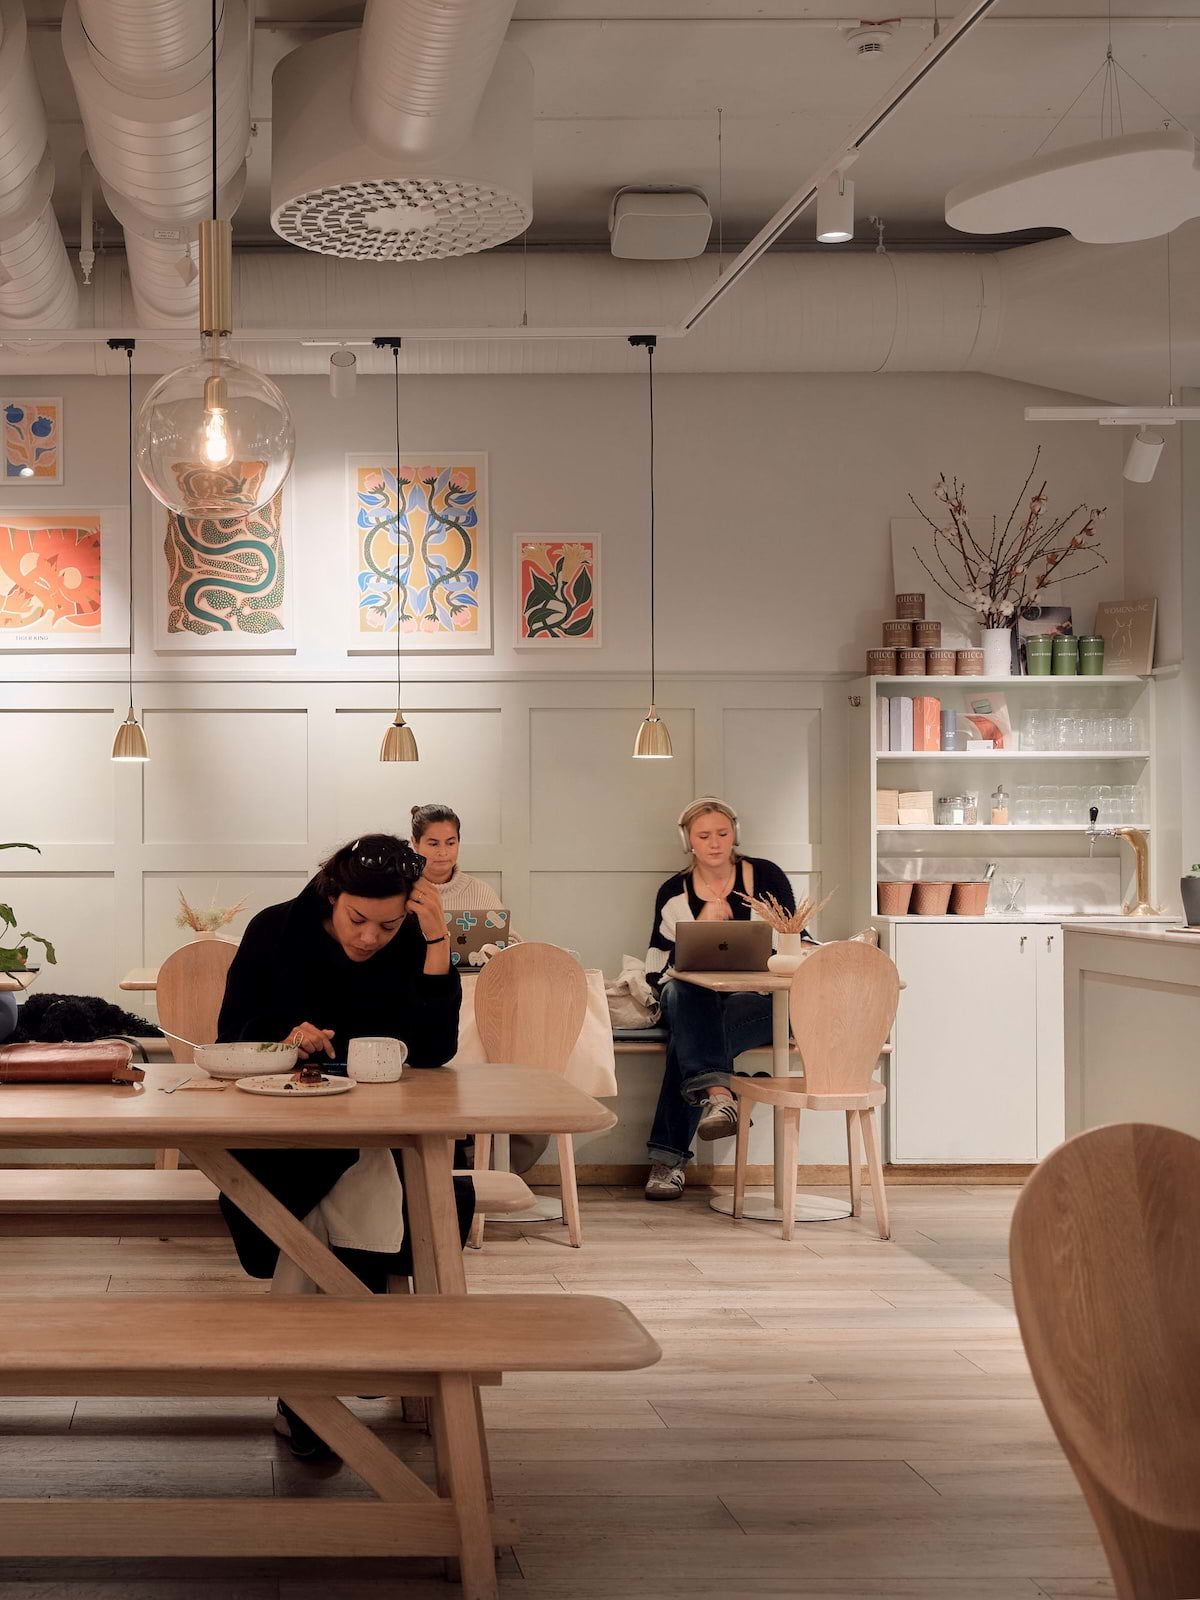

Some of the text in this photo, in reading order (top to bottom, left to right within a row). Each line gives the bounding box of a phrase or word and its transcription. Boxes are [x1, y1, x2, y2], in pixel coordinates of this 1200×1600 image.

[897, 595, 923, 603] CHICCA
[885, 623, 911, 631] CHICCA
[869, 651, 895, 659] CHICCA
[958, 651, 984, 659] CHICCA
